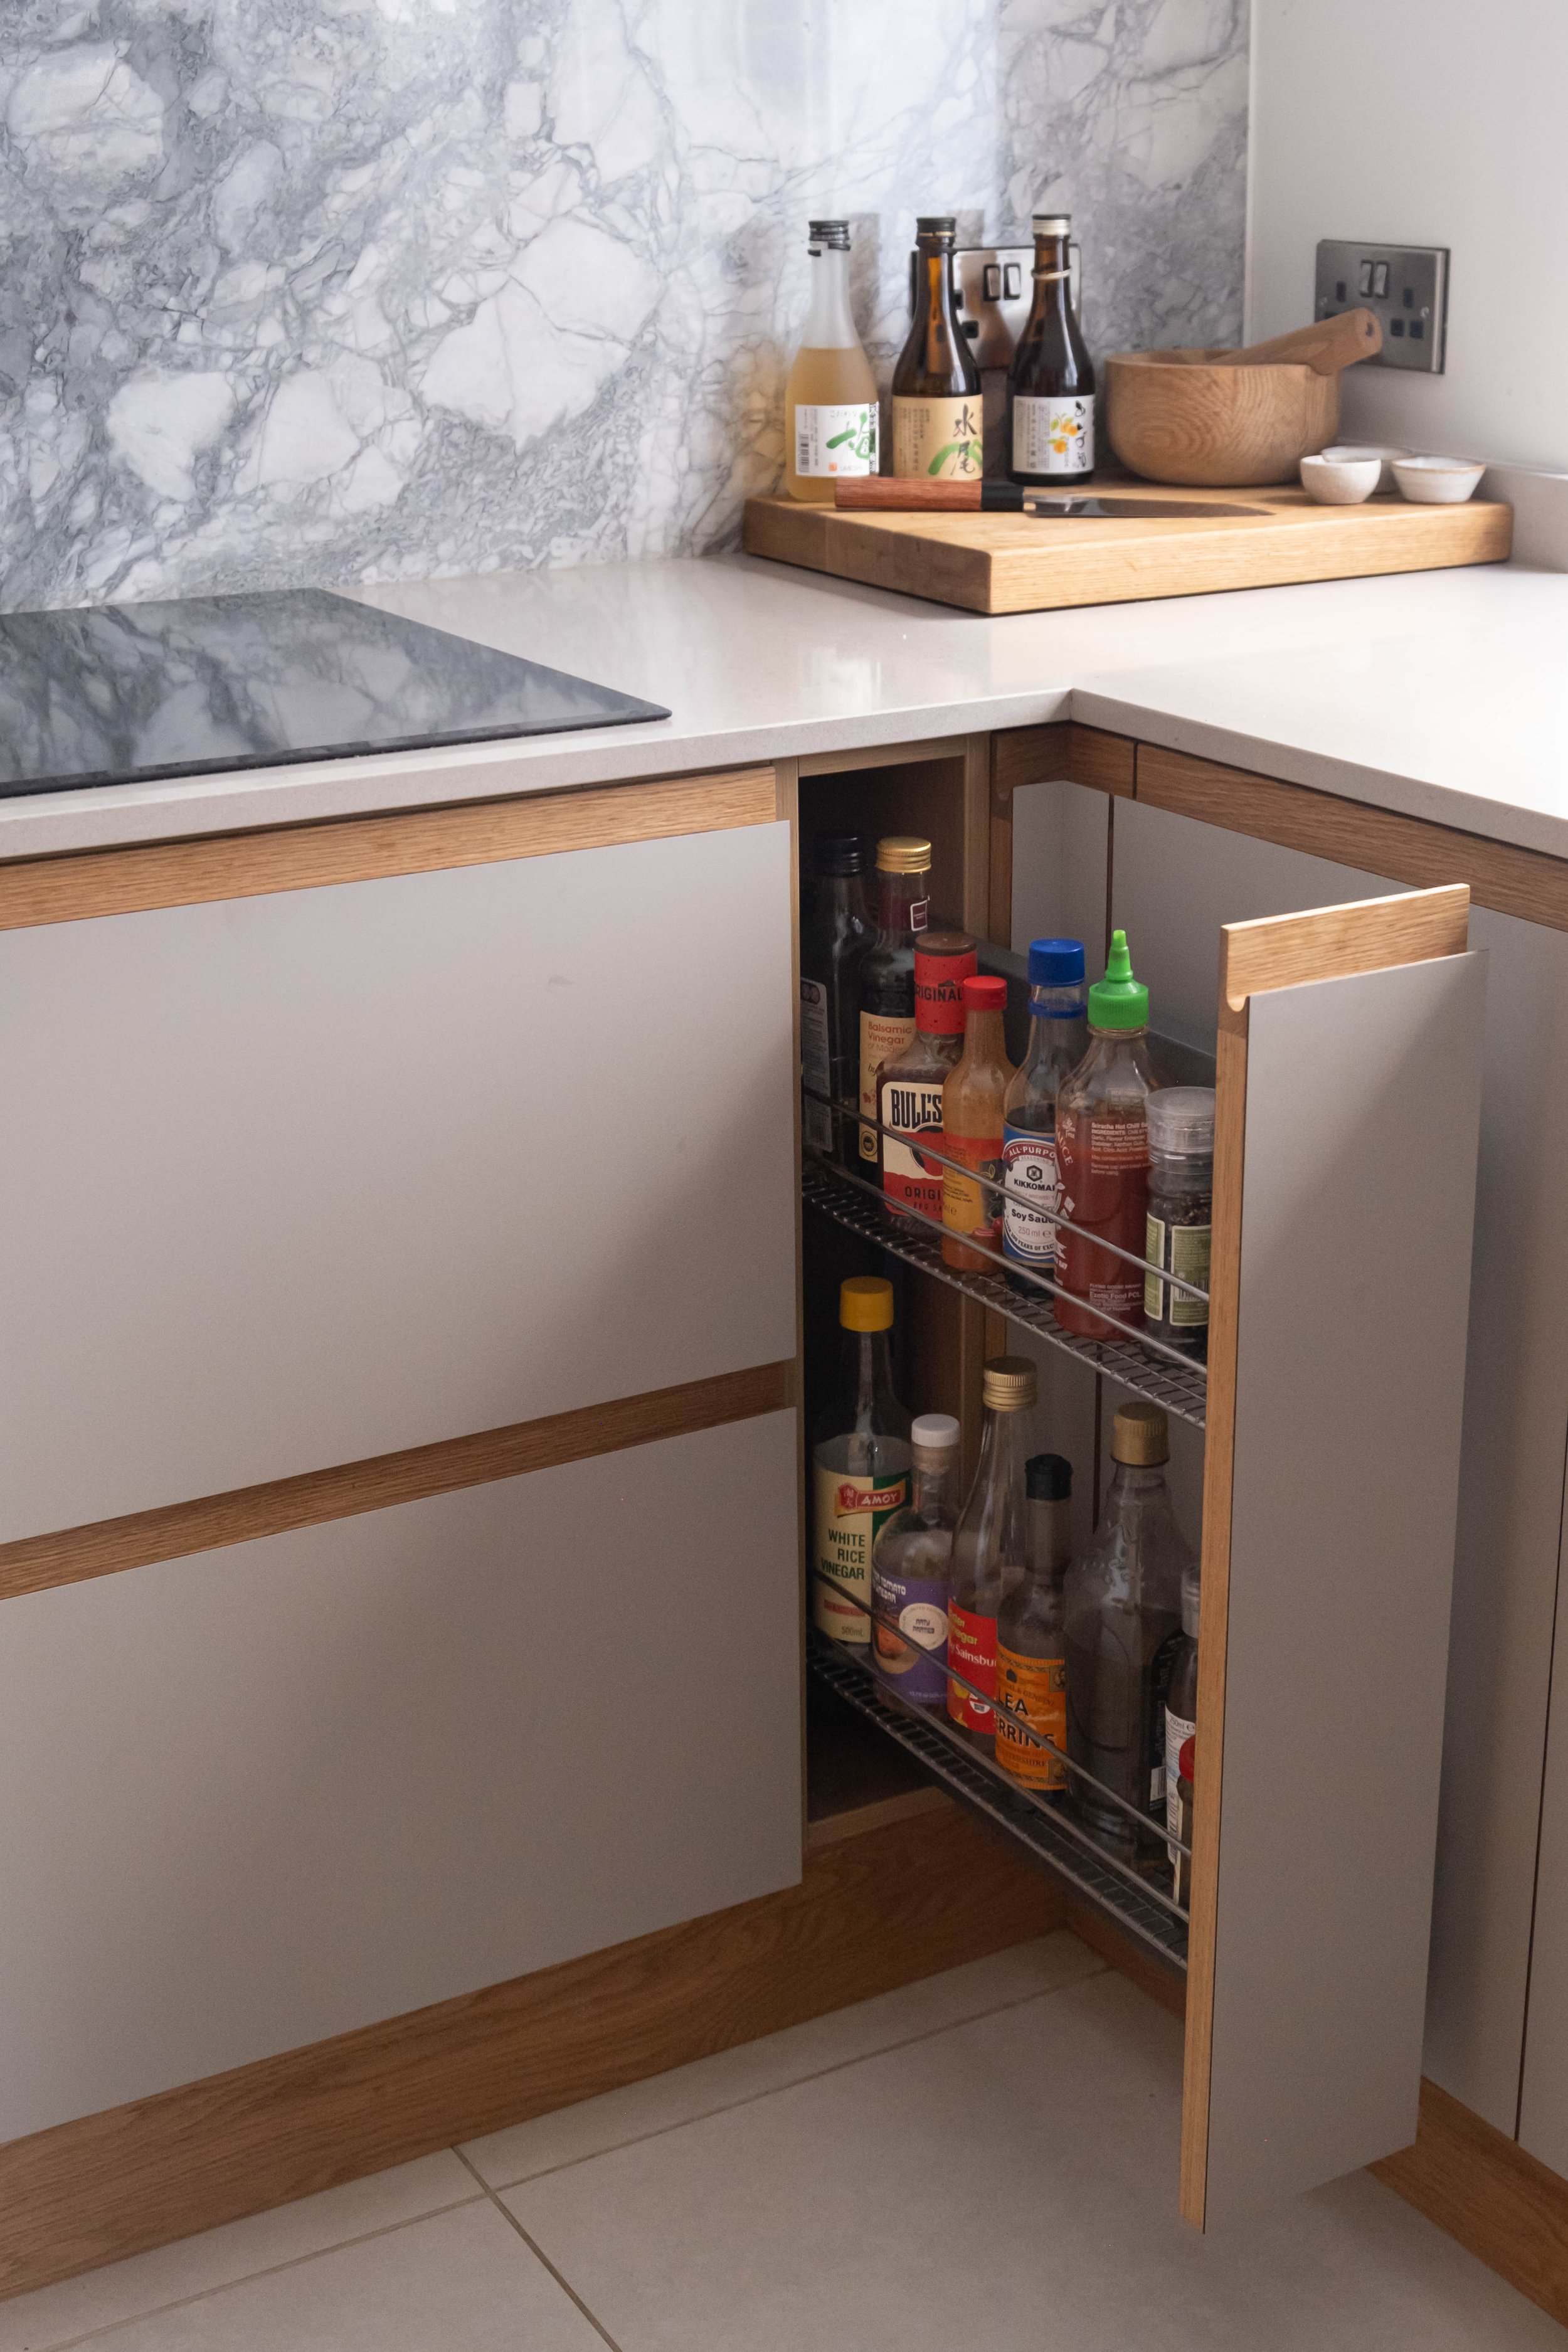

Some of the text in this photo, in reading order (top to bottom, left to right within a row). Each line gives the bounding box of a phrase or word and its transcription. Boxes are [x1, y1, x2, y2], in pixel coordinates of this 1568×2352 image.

[951, 403, 977, 475] 水尾
[915, 985, 962, 1002] RIGINAL
[868, 1021, 912, 1034] Balsamic
[868, 1032, 905, 1046] Vinegar
[1009, 1146, 1055, 1158] ALL-PURPO
[905, 1187, 943, 1201] ORIGI
[1012, 1209, 1055, 1224] Soy Sauc
[1019, 1226, 1030, 1236] 250
[1018, 1239, 1033, 1251] YEARS
[1042, 1242, 1054, 1251] EXC
[861, 1493, 898, 1506] AMOY
[828, 1528, 866, 1547] WHITE
[837, 1548, 866, 1564] RICE
[821, 1557, 865, 1580] VINEGAR
[881, 1576, 906, 1596] TOMATO
[999, 1686, 1029, 1716] LEA
